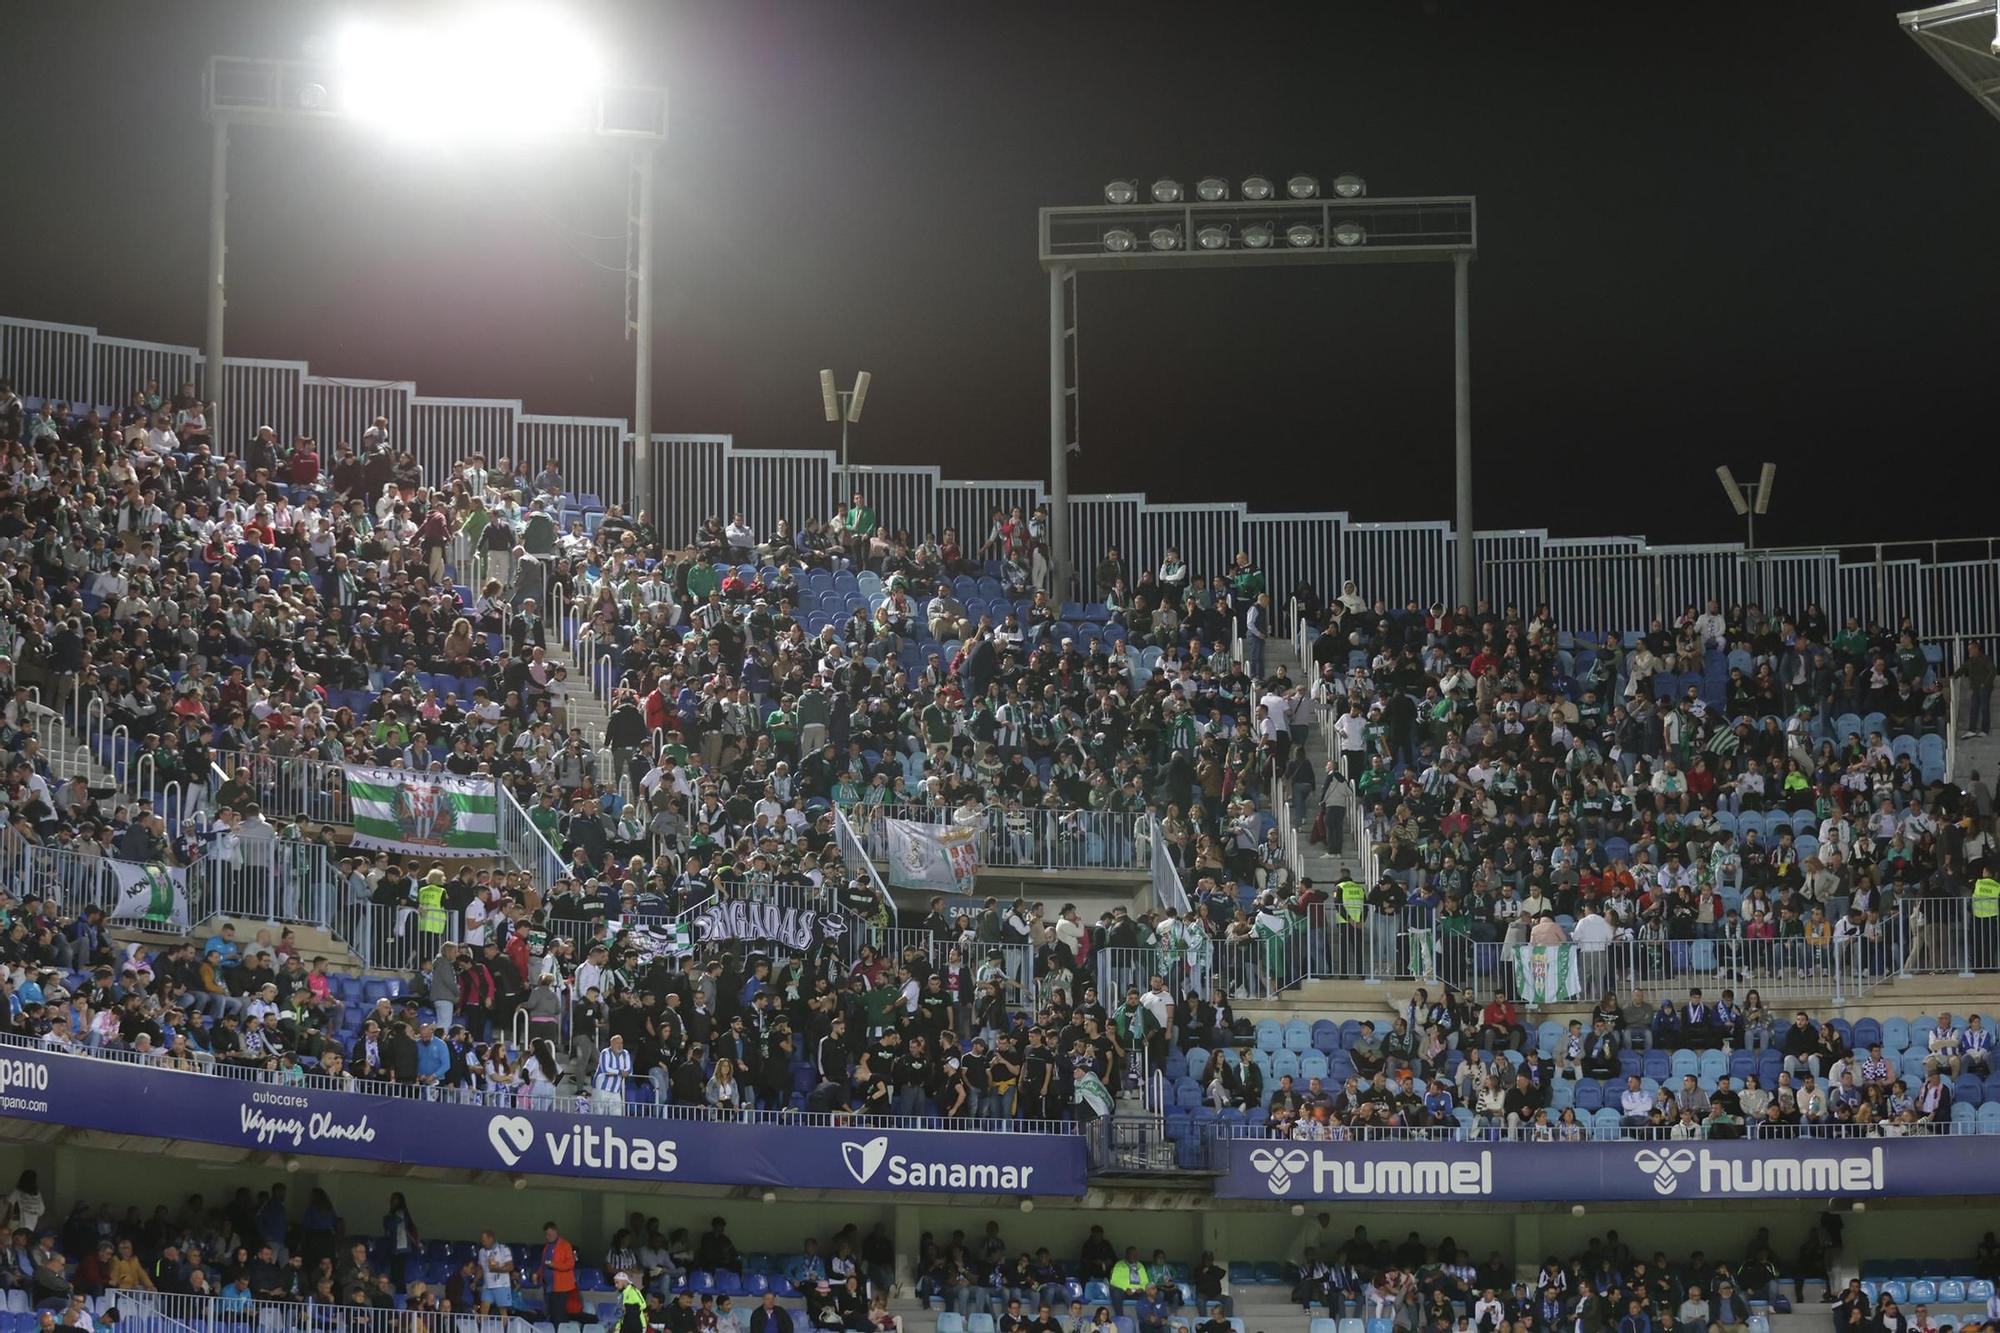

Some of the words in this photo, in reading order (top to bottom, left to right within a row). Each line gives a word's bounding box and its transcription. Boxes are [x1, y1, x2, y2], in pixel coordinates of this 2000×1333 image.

[253, 1091, 309, 1108] autocares
[241, 1103, 306, 1147] Vázquez
[309, 1111, 376, 1142] Olmedo
[545, 1124, 678, 1172] vithas
[1699, 1146, 1884, 1192] hummel
[887, 1155, 1033, 1189] Sanamar
[1313, 1150, 1492, 1194] hummel
